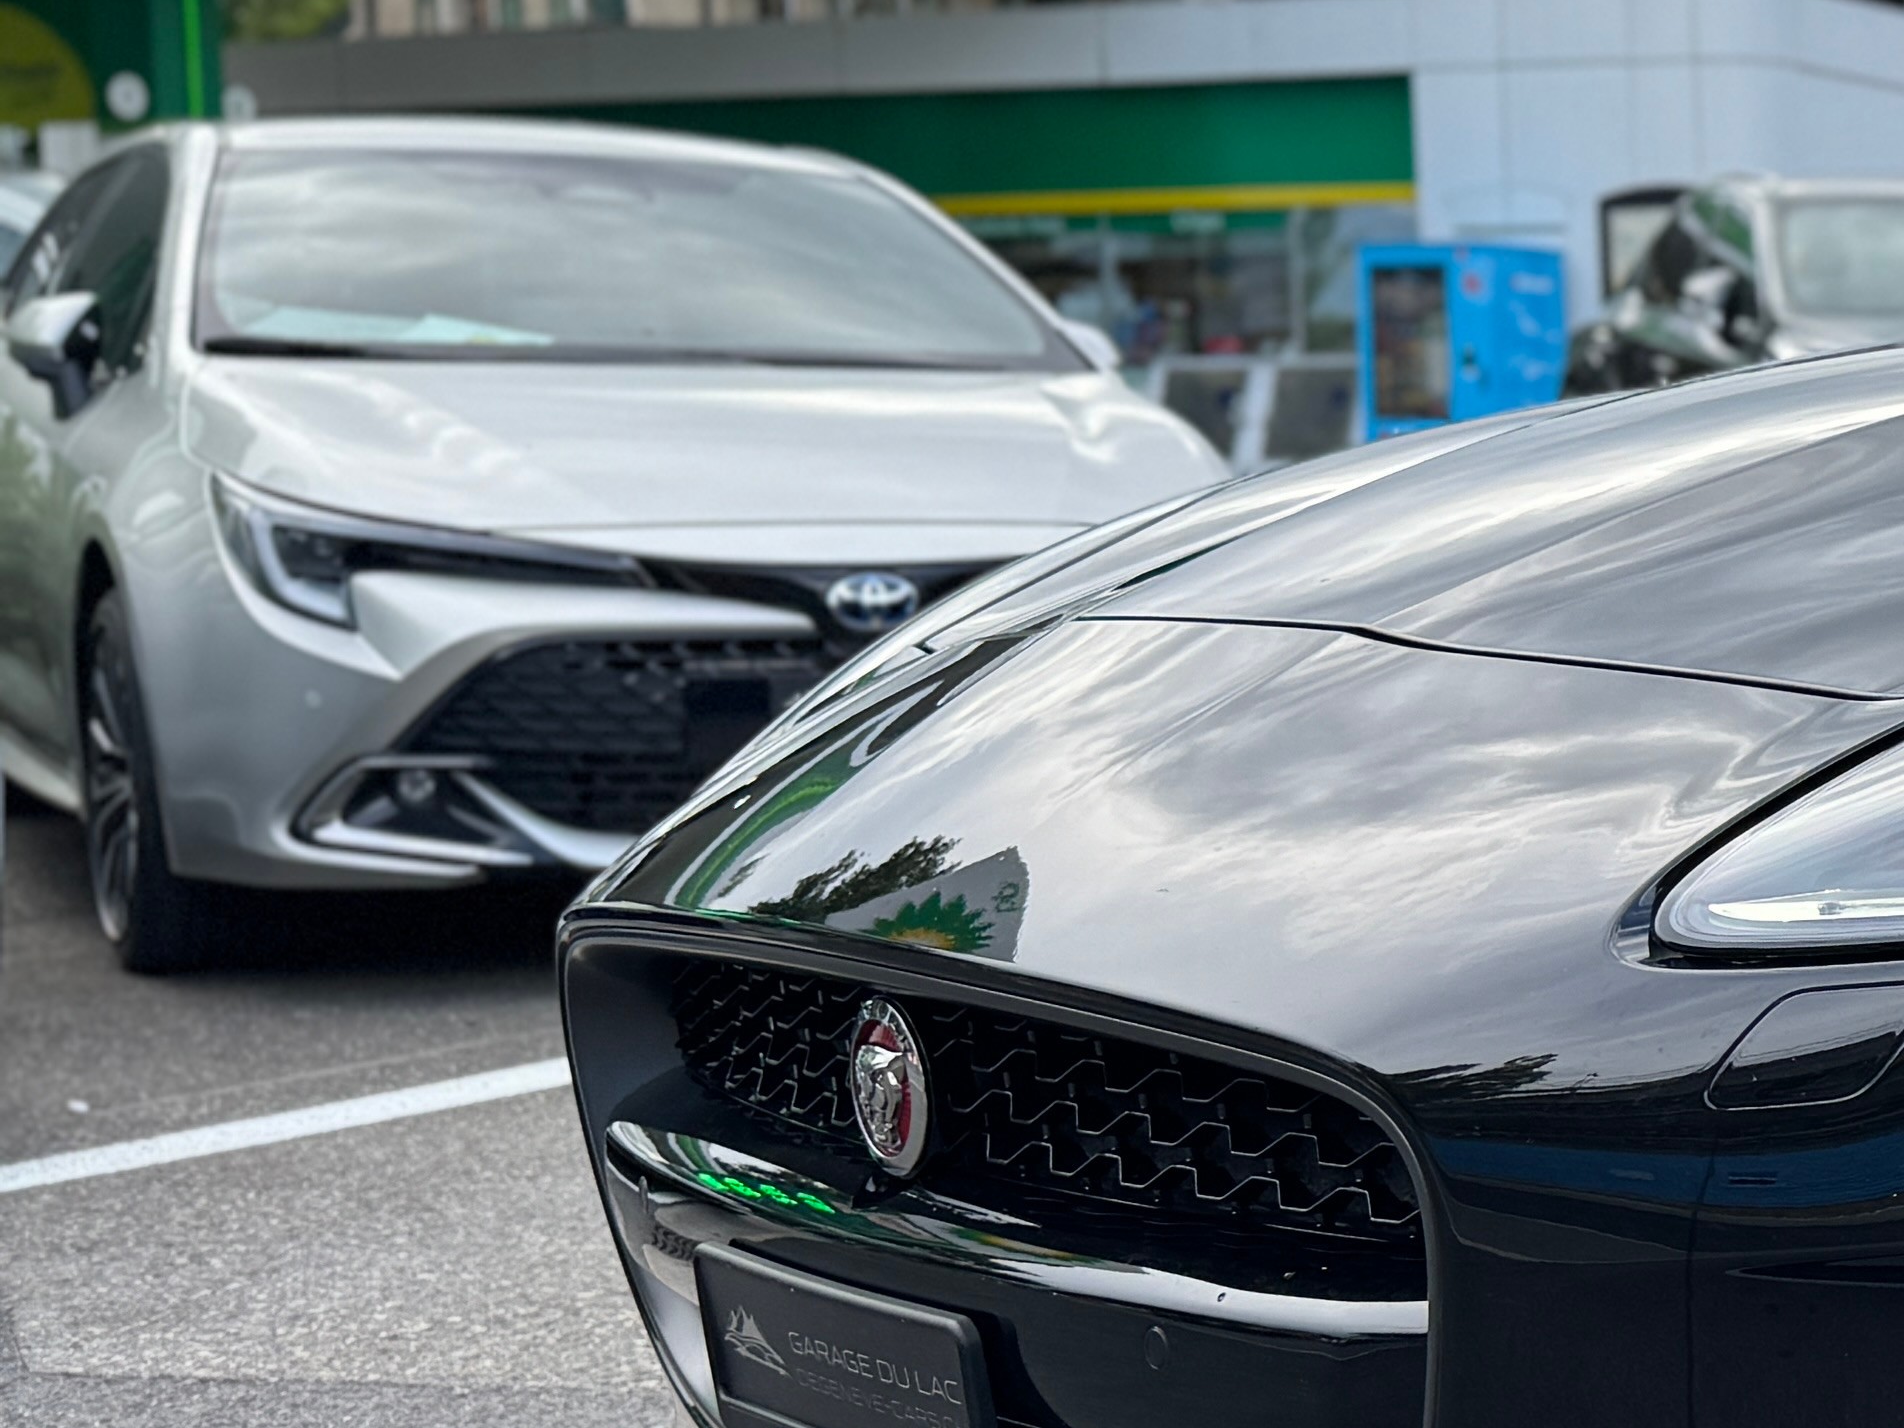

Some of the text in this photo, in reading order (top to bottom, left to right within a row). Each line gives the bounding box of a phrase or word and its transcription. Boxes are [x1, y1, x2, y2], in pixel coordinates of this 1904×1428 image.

[787, 1330, 963, 1405] GARAGE DU LAC
